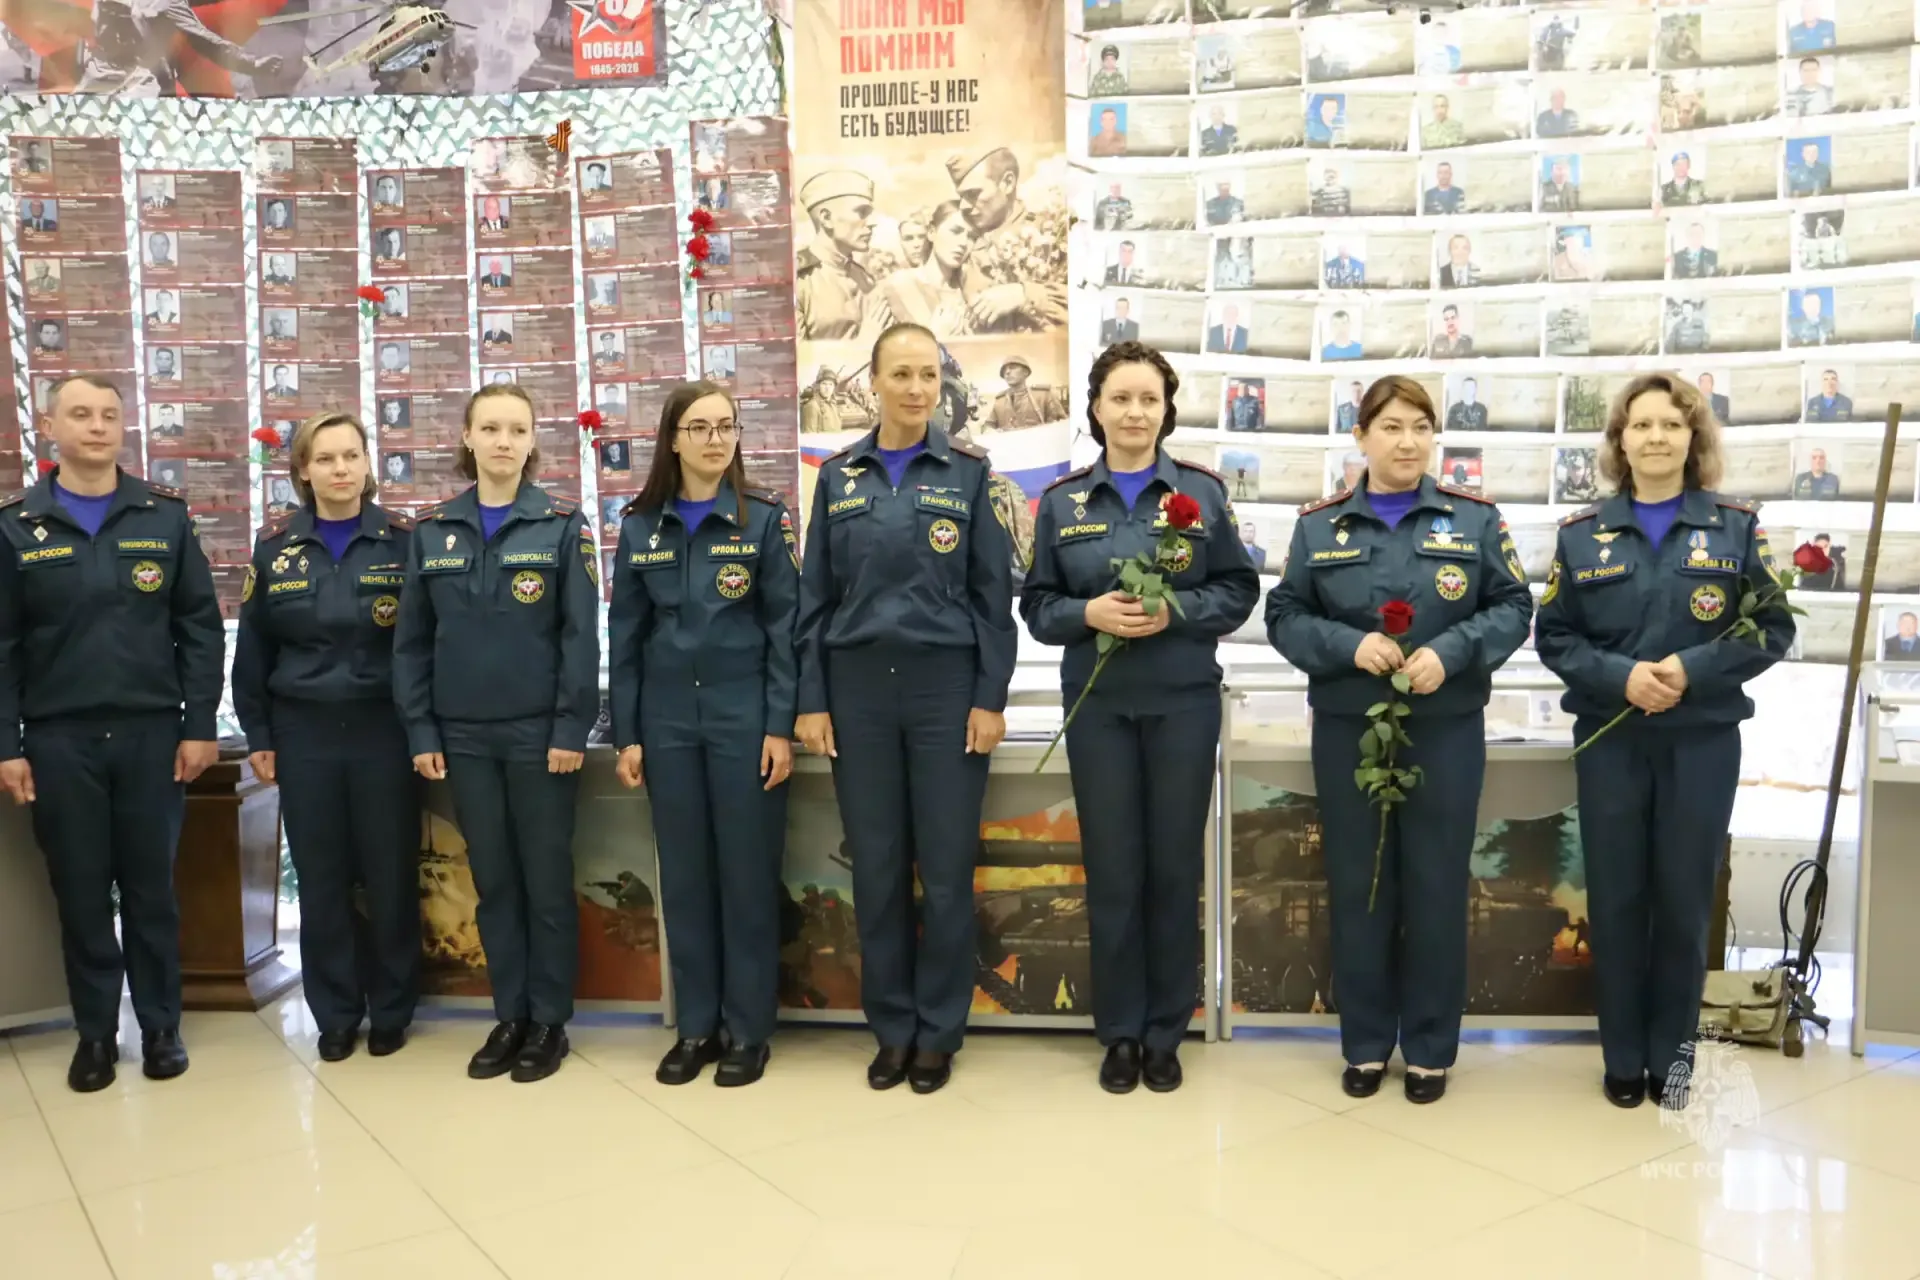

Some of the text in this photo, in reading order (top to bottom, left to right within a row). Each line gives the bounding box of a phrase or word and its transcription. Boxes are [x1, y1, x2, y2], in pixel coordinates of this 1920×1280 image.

[839, 0, 965, 30] ПОКА МЫ
[581, 40, 645, 60] ПОБЕДА
[839, 31, 956, 74] ПОМНИМ
[946, 78, 979, 103] НАС
[840, 108, 970, 138] ЕСТЬ БУДУЩЕЕ!
[1075, 523, 1107, 535] РОССИИ
[39, 546, 73, 559] РОССИИ
[648, 551, 674, 563] РОССИИ
[438, 557, 465, 568] РОССИИ
[1594, 563, 1625, 577] РОССИИ
